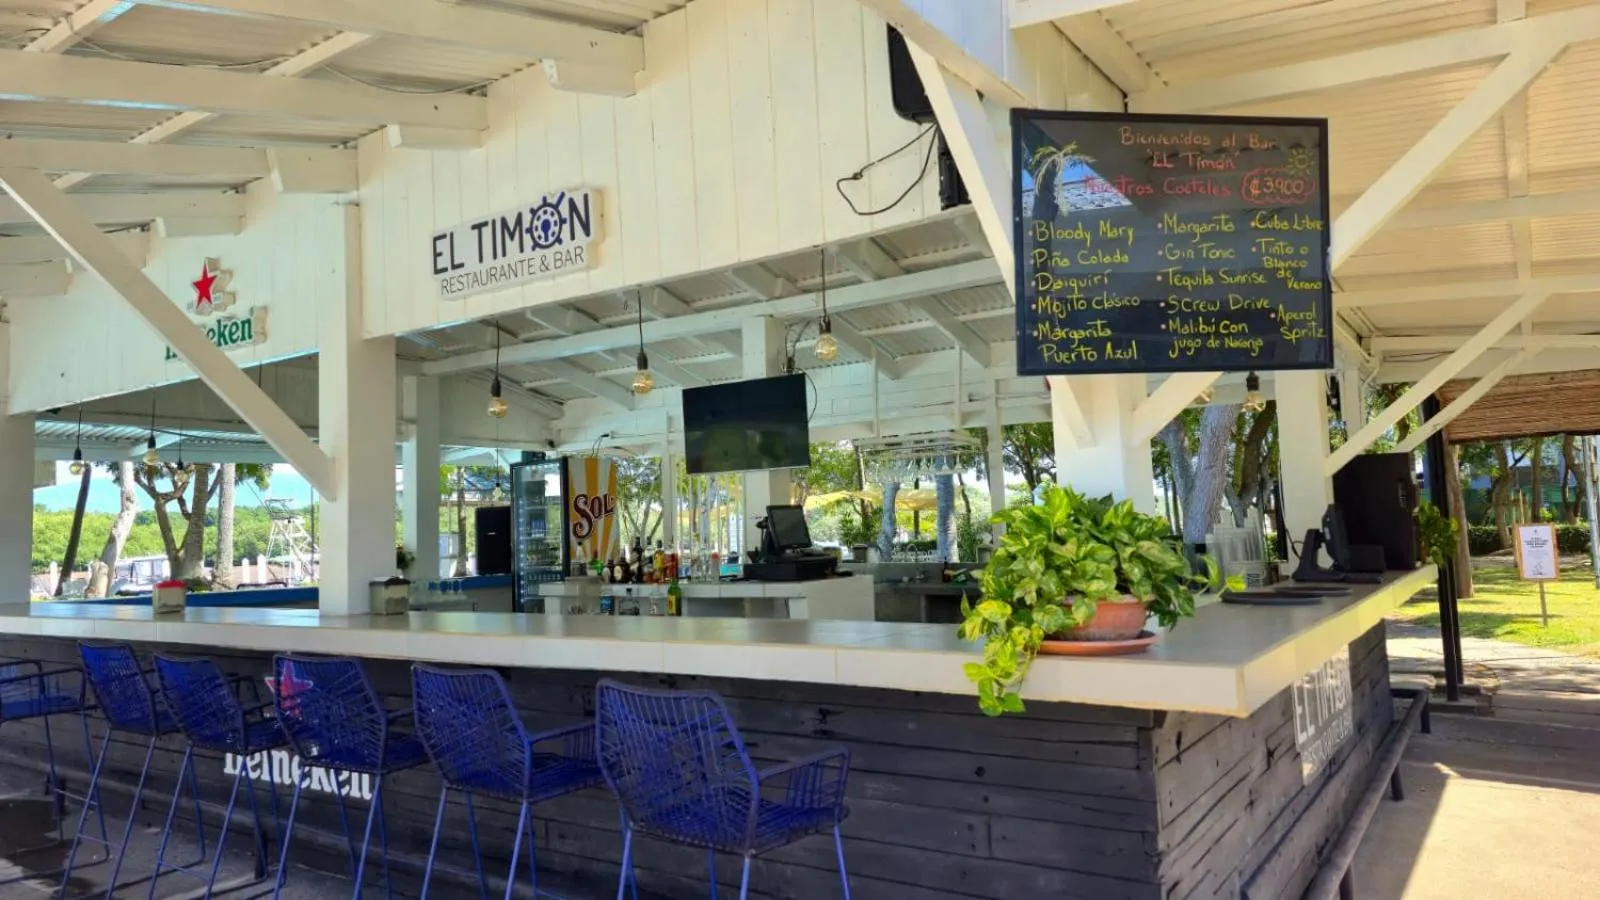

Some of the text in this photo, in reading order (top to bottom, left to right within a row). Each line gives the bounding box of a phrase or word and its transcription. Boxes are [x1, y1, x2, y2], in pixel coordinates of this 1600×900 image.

[1221, 132, 1236, 148] al
[1249, 132, 1277, 150] Bar
[1163, 213, 1236, 243] Margarita
[1256, 210, 1290, 229] Cuba
[1033, 220, 1134, 247] Bloody Mary
[432, 231, 465, 275] EL
[1031, 248, 1129, 268] Piña Colada
[1165, 243, 1195, 260] Gin
[1256, 238, 1294, 255] Tinto
[441, 245, 585, 295] RESTAURANTE & BAR
[1263, 256, 1309, 269] Blanco
[1160, 266, 1268, 290] Tequila Sunrise
[1287, 278, 1323, 290] Verano
[1038, 294, 1088, 319] Mojito
[1276, 300, 1317, 325] Aperol
[1038, 319, 1113, 349] Margarita
[1206, 335, 1221, 348] de
[1038, 340, 1138, 364] Puerto Azul
